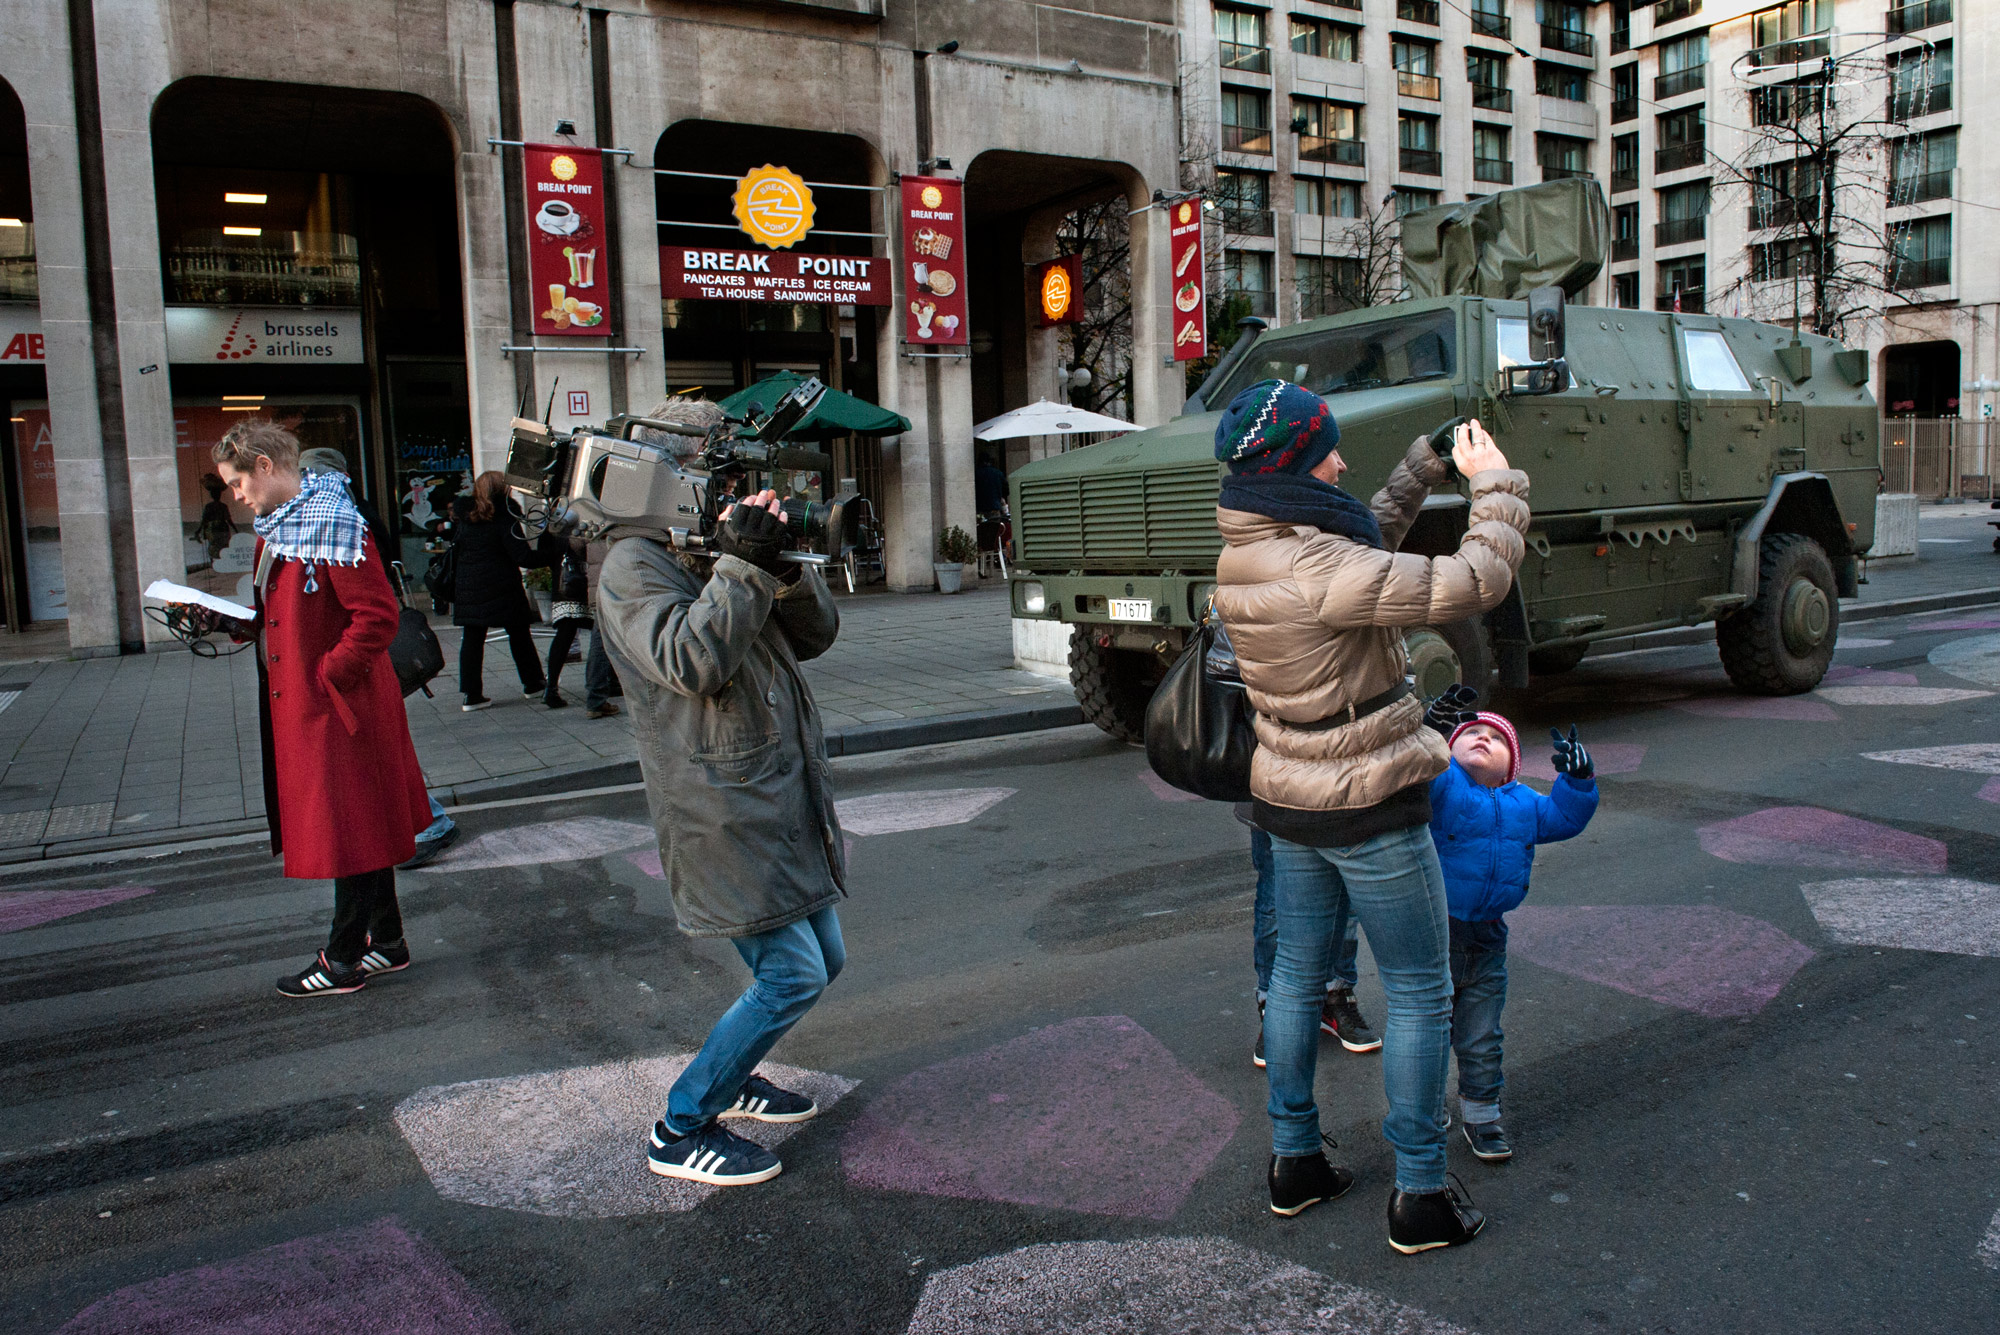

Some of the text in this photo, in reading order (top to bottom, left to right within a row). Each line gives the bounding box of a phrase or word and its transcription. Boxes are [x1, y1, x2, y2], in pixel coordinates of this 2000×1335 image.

[537, 182, 592, 194] BREAK POINT
[760, 184, 789, 196] BREAK
[911, 210, 954, 221] BREAK POINT
[764, 221, 788, 231] POINT
[683, 250, 871, 278] BREAK POINT
[683, 273, 871, 292] PANCAKES WAFFLES ICE CREAM
[701, 287, 856, 303] TEA HOUSE SANDWICH BAR
[264, 320, 339, 337] brussels
[266, 340, 333, 357] airlines
[573, 395, 584, 411] H
[1116, 602, 1148, 618] 71677
